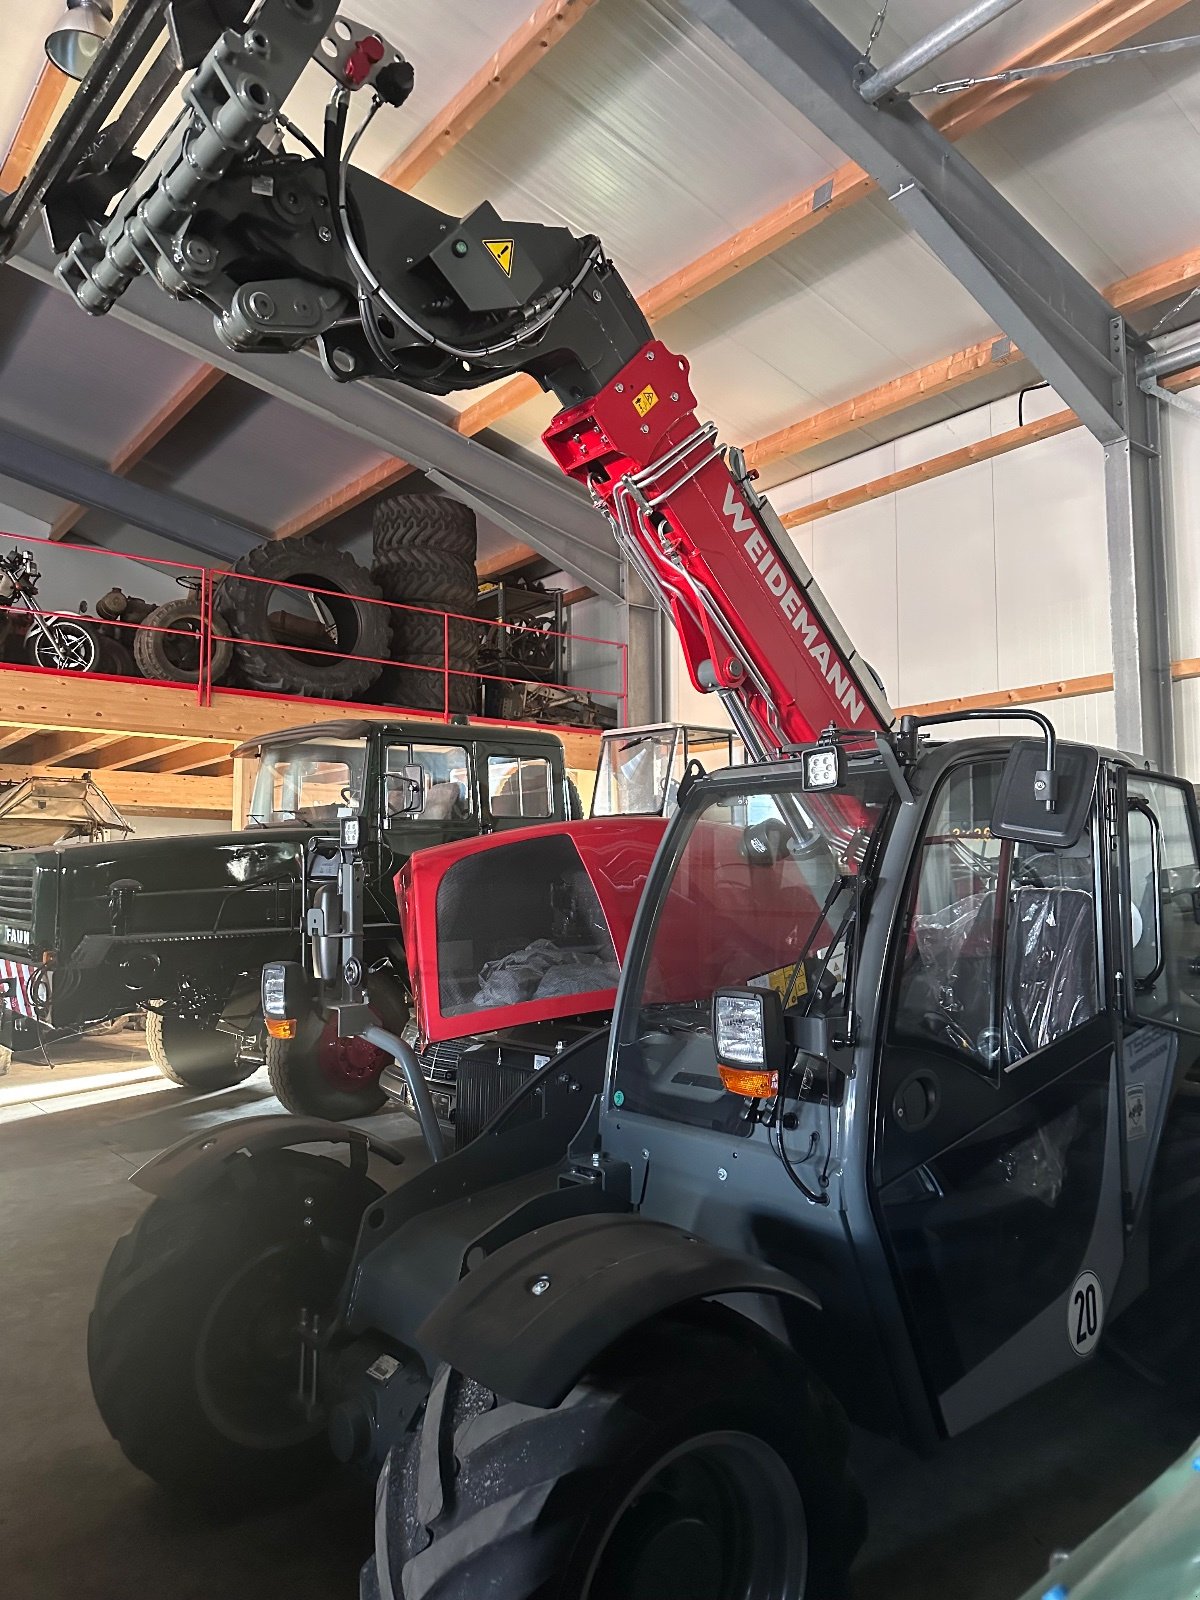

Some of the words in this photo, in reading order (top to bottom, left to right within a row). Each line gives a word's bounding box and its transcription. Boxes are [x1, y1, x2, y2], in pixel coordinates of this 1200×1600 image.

[723, 482, 865, 723] WEIDEMANN
[6, 928, 30, 945] FAUN
[1074, 1283, 1097, 1345] 20
